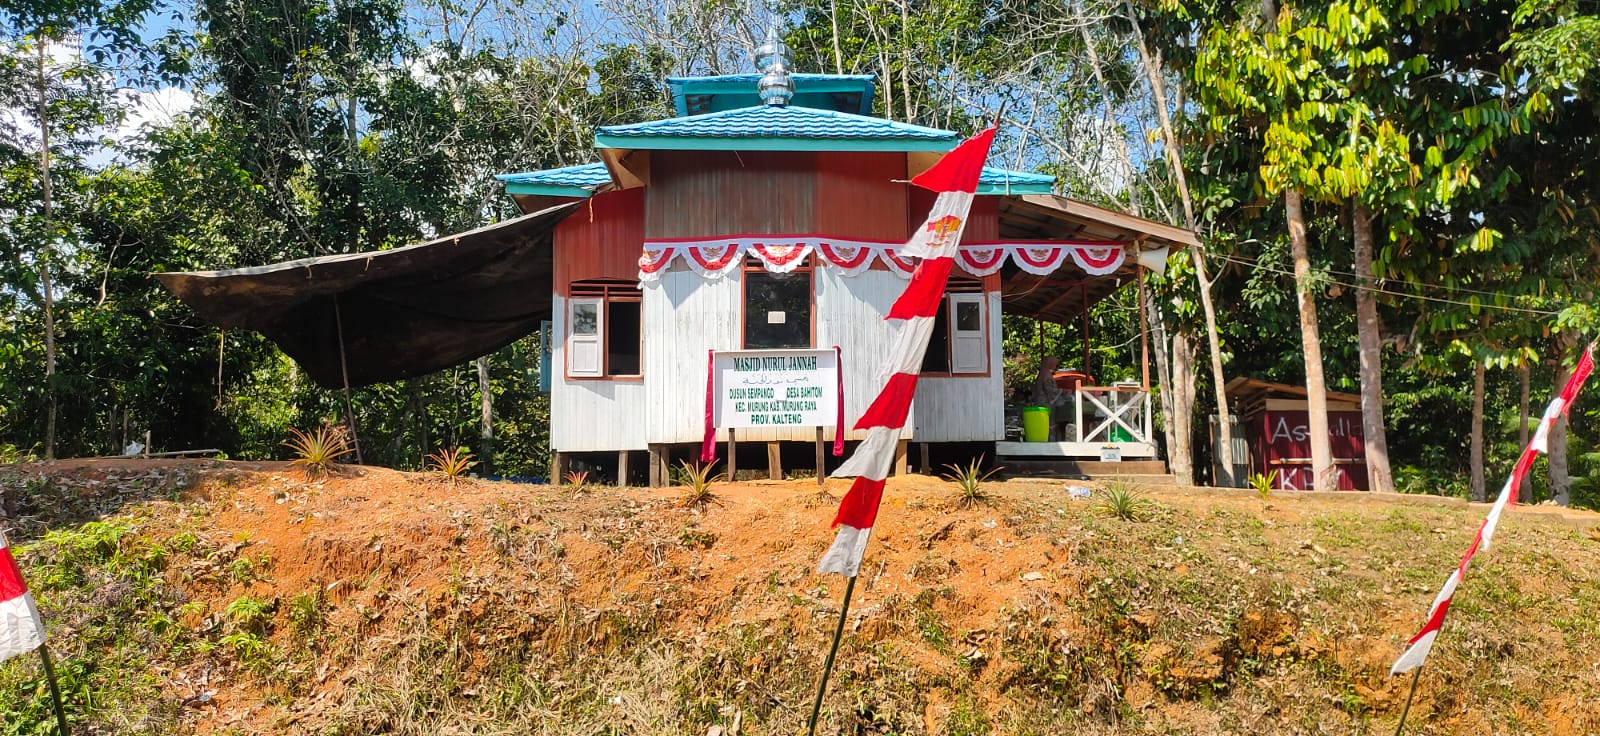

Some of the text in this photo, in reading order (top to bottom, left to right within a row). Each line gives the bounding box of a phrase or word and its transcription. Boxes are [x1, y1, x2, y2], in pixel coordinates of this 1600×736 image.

[733, 356, 817, 372] MASJID NURUL JANNAH
[729, 388, 747, 399] DUSUN
[786, 387, 800, 398] DESA
[748, 401, 769, 412] MURUNG
[782, 400, 804, 411] MURUNG
[804, 400, 817, 411] RAYA
[751, 413, 803, 425] PROV. KALTENG
